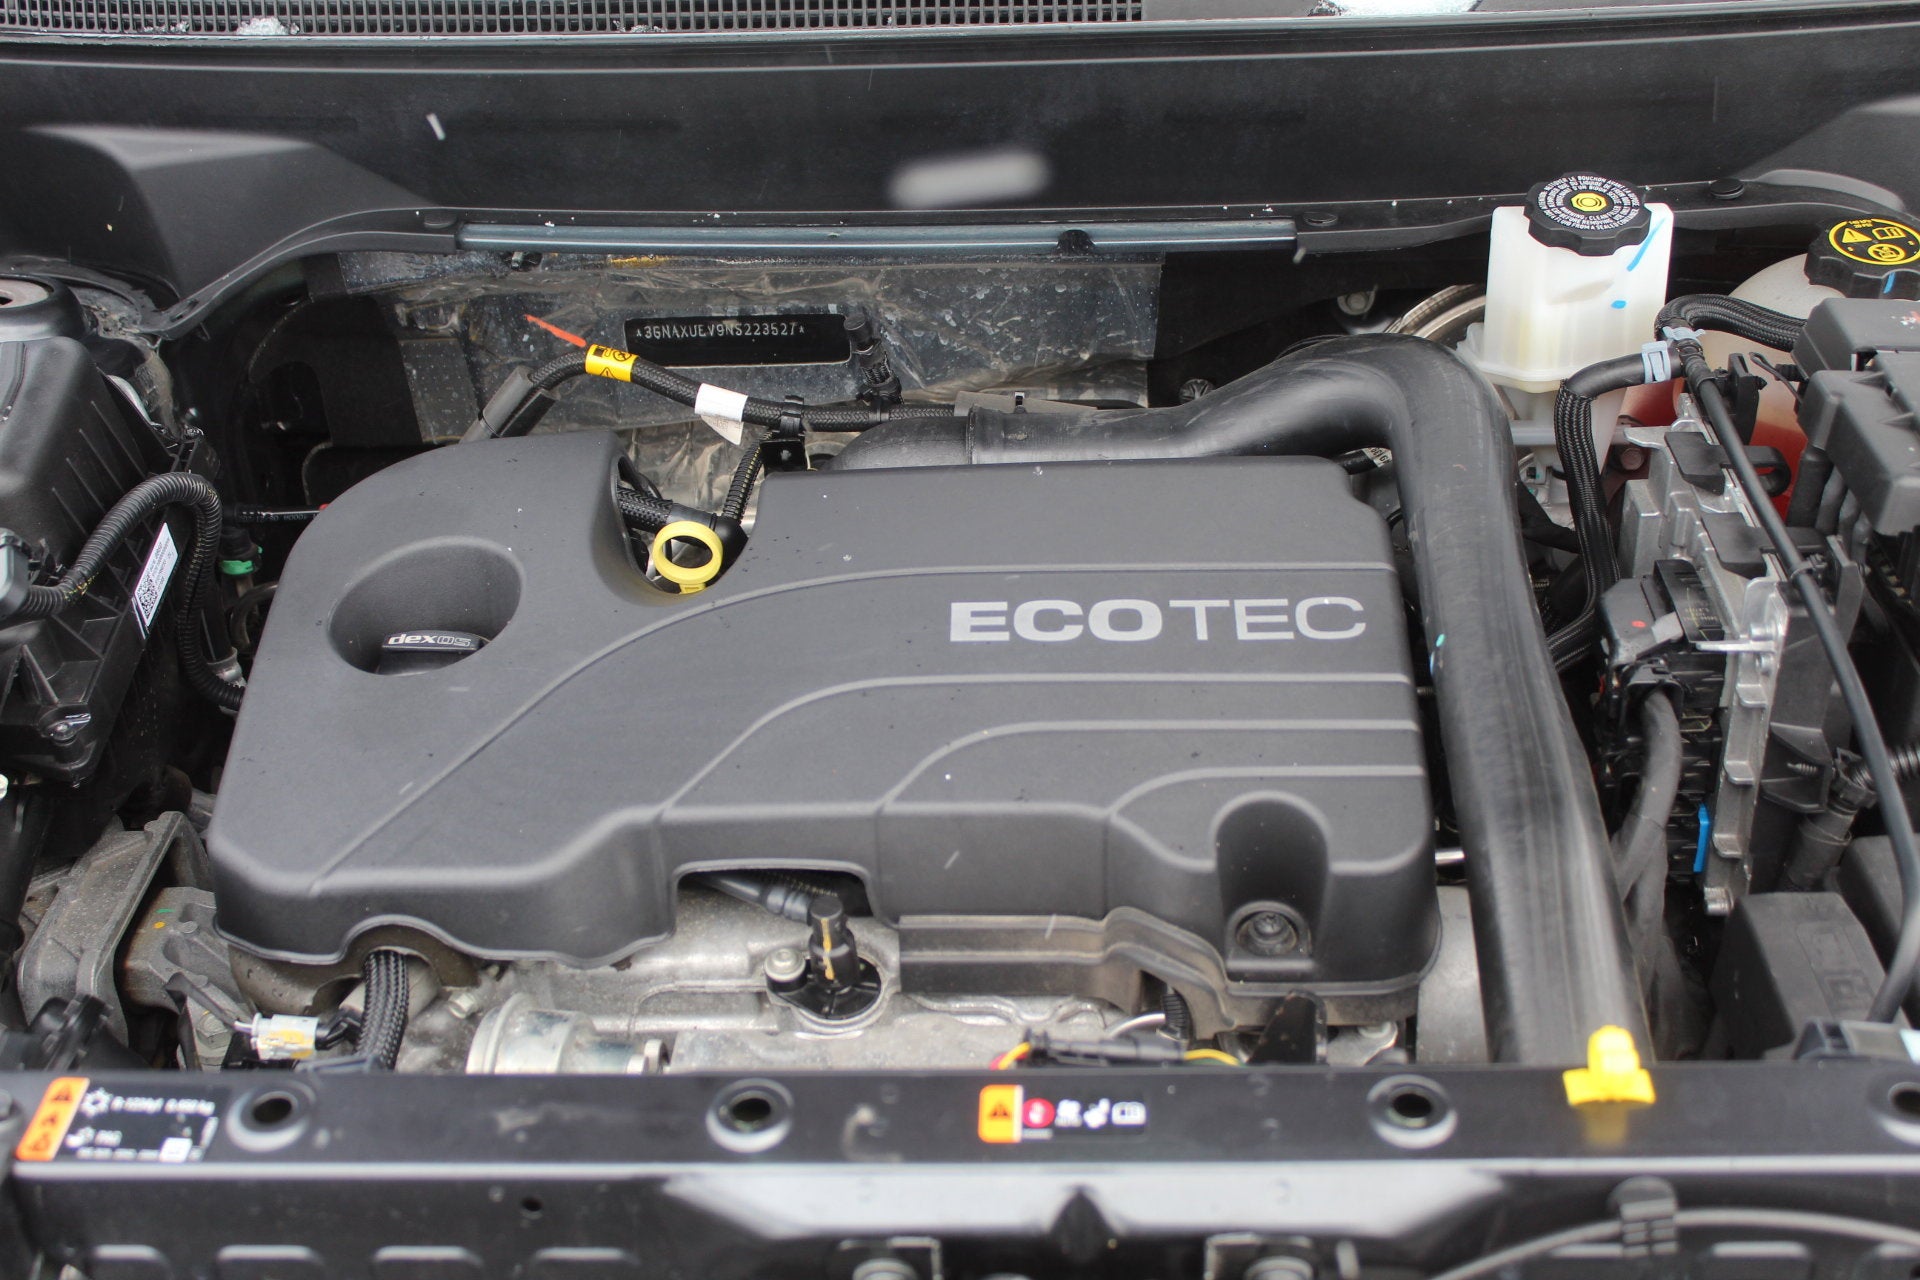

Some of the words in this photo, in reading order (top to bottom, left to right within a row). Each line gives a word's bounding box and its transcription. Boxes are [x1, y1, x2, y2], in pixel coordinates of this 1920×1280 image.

[1577, 175, 1607, 183] BOUCHON
[1588, 213, 1609, 221] CLEAN
[1571, 222, 1590, 230] FROM
[949, 597, 1367, 643] ECOTEC
[387, 633, 472, 647] dexos
